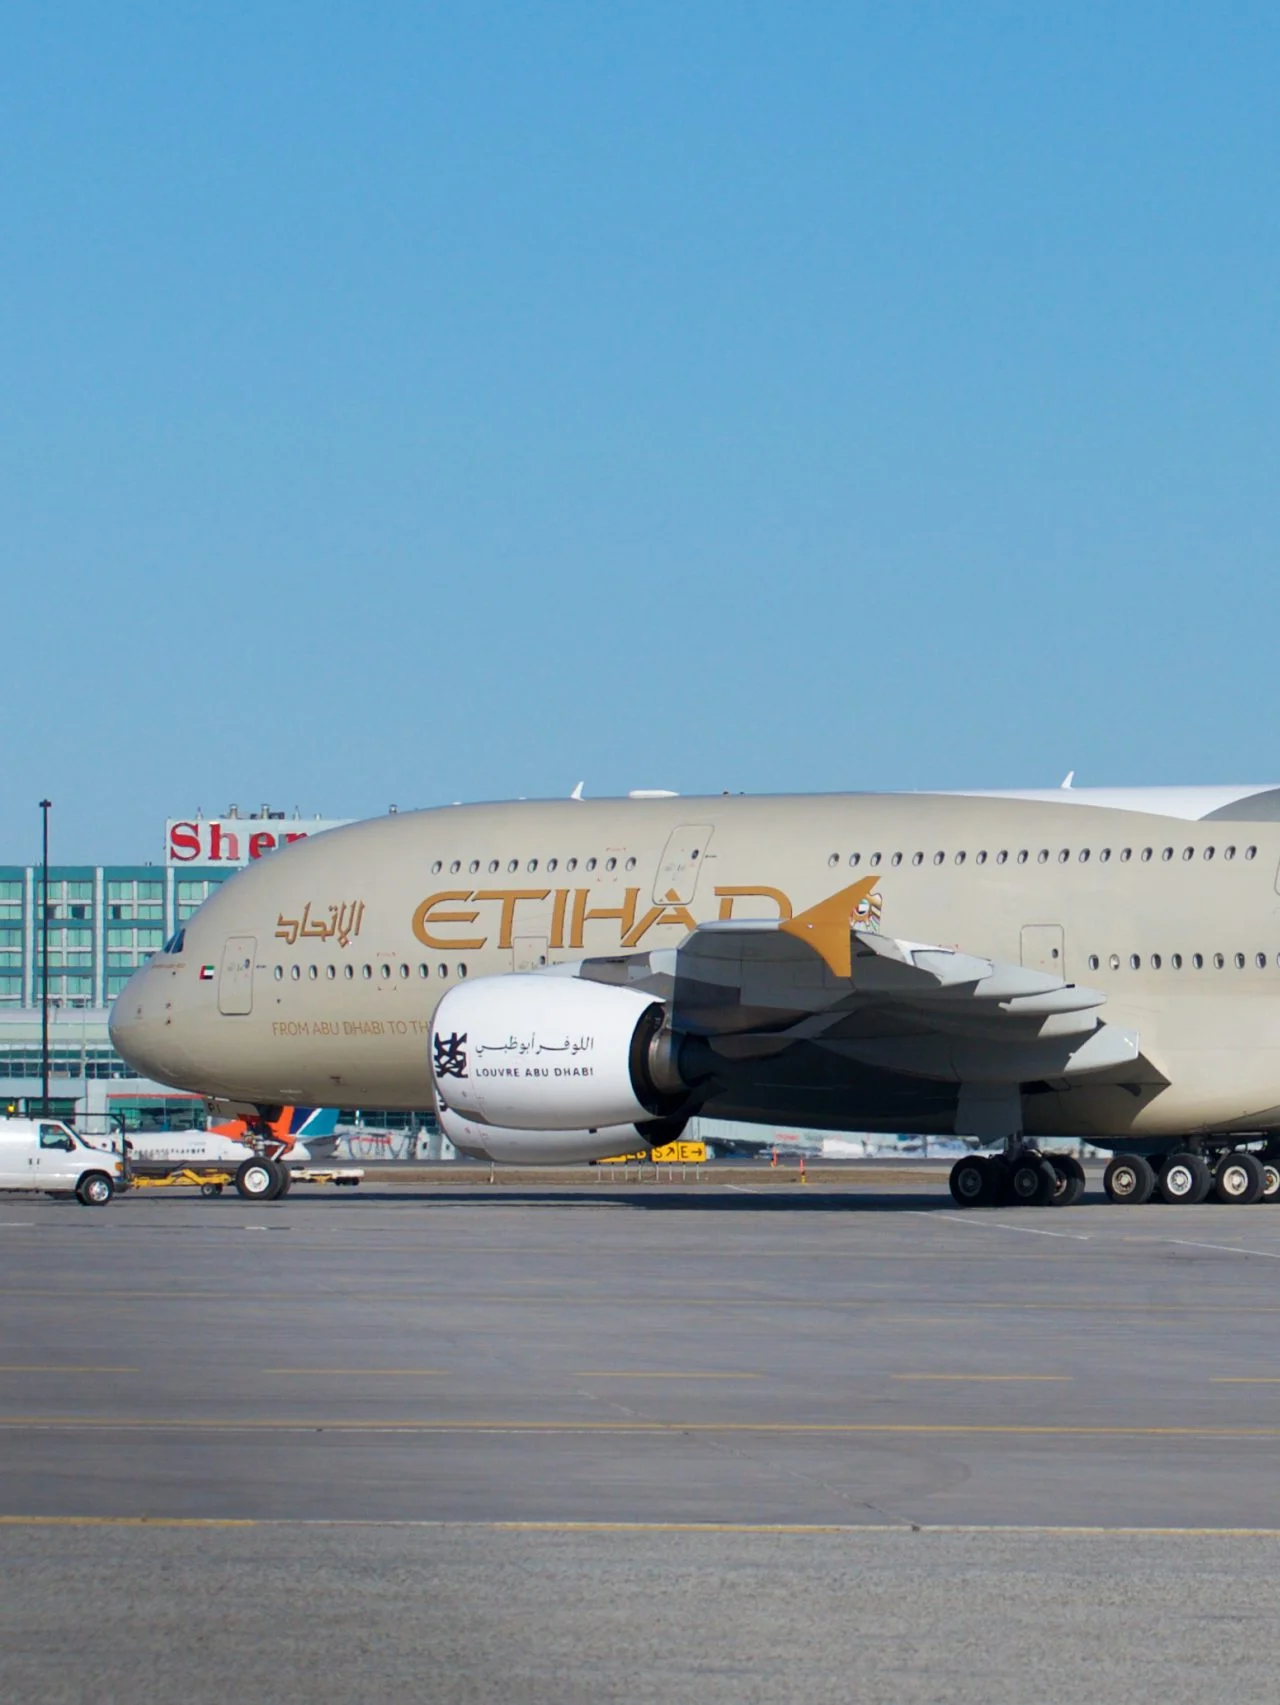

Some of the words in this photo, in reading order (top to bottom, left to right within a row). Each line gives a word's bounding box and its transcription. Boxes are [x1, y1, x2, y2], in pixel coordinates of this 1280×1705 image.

[272, 1021, 310, 1036] FROM
[313, 1021, 339, 1036] ABU
[343, 1021, 385, 1035] DHABI
[388, 1021, 408, 1035] TO
[409, 1021, 432, 1034] TH
[536, 1034, 594, 1056] اللوفر
[476, 1068, 520, 1078] LOUVRE
[525, 1067, 549, 1078] ABU
[554, 1067, 594, 1077] DHABI
[680, 1146, 689, 1159] E
